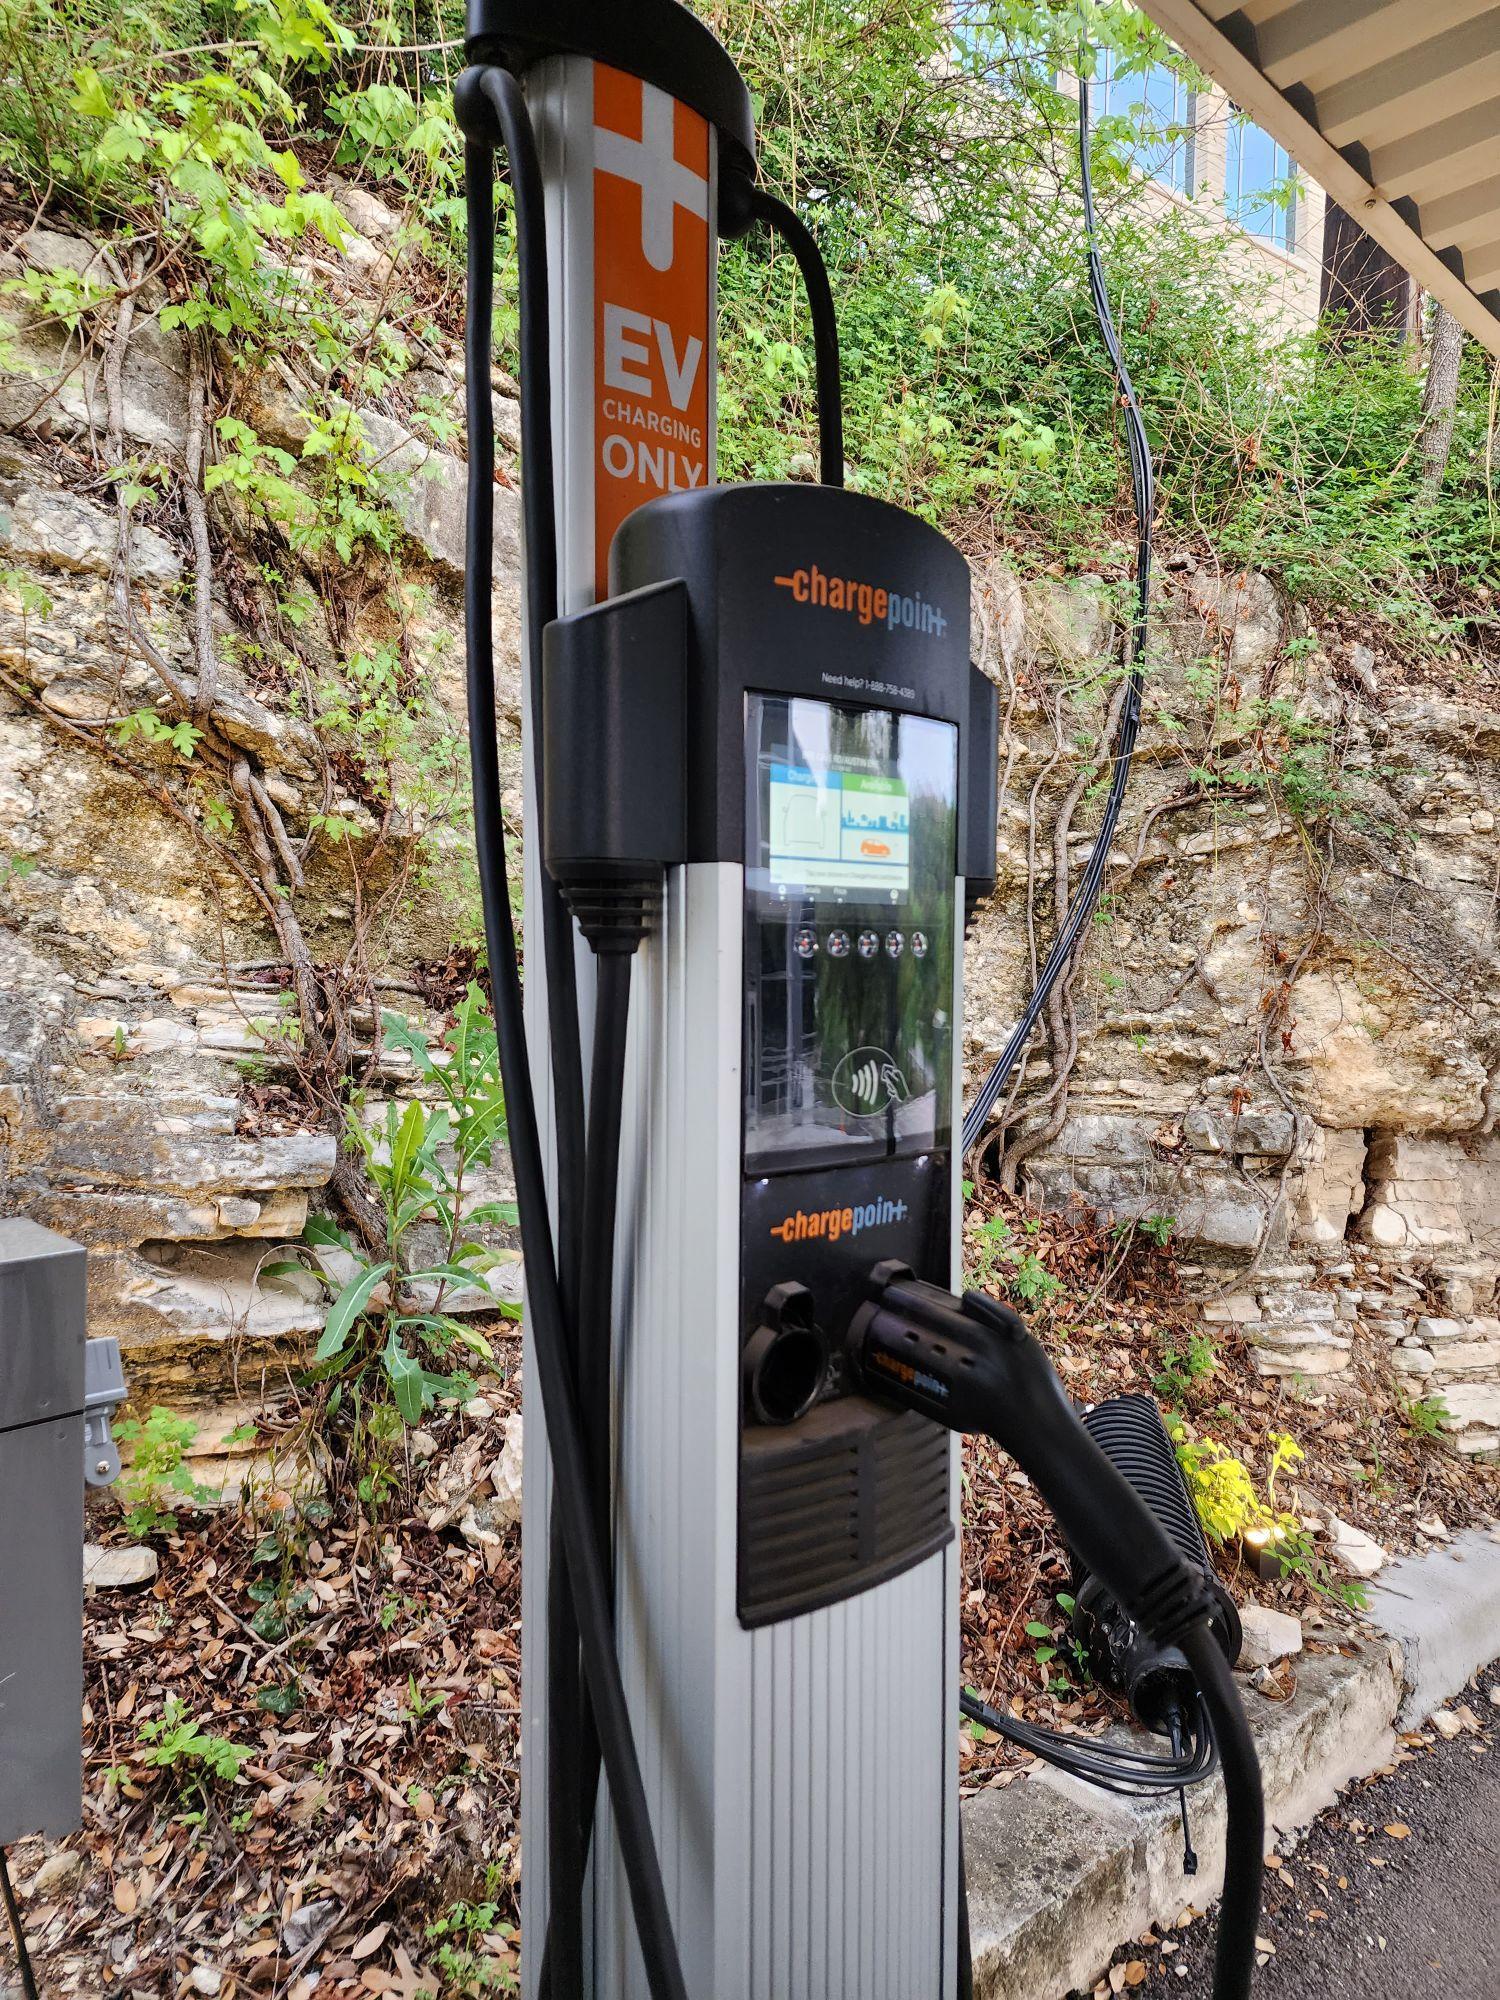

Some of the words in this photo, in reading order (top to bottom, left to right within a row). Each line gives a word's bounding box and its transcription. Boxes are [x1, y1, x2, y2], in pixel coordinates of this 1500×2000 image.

[603, 302, 703, 412] EV
[603, 399, 701, 449] CHARGING
[602, 434, 703, 492] ONLY
[821, 671, 843, 686] Need
[843, 675, 864, 690] help?
